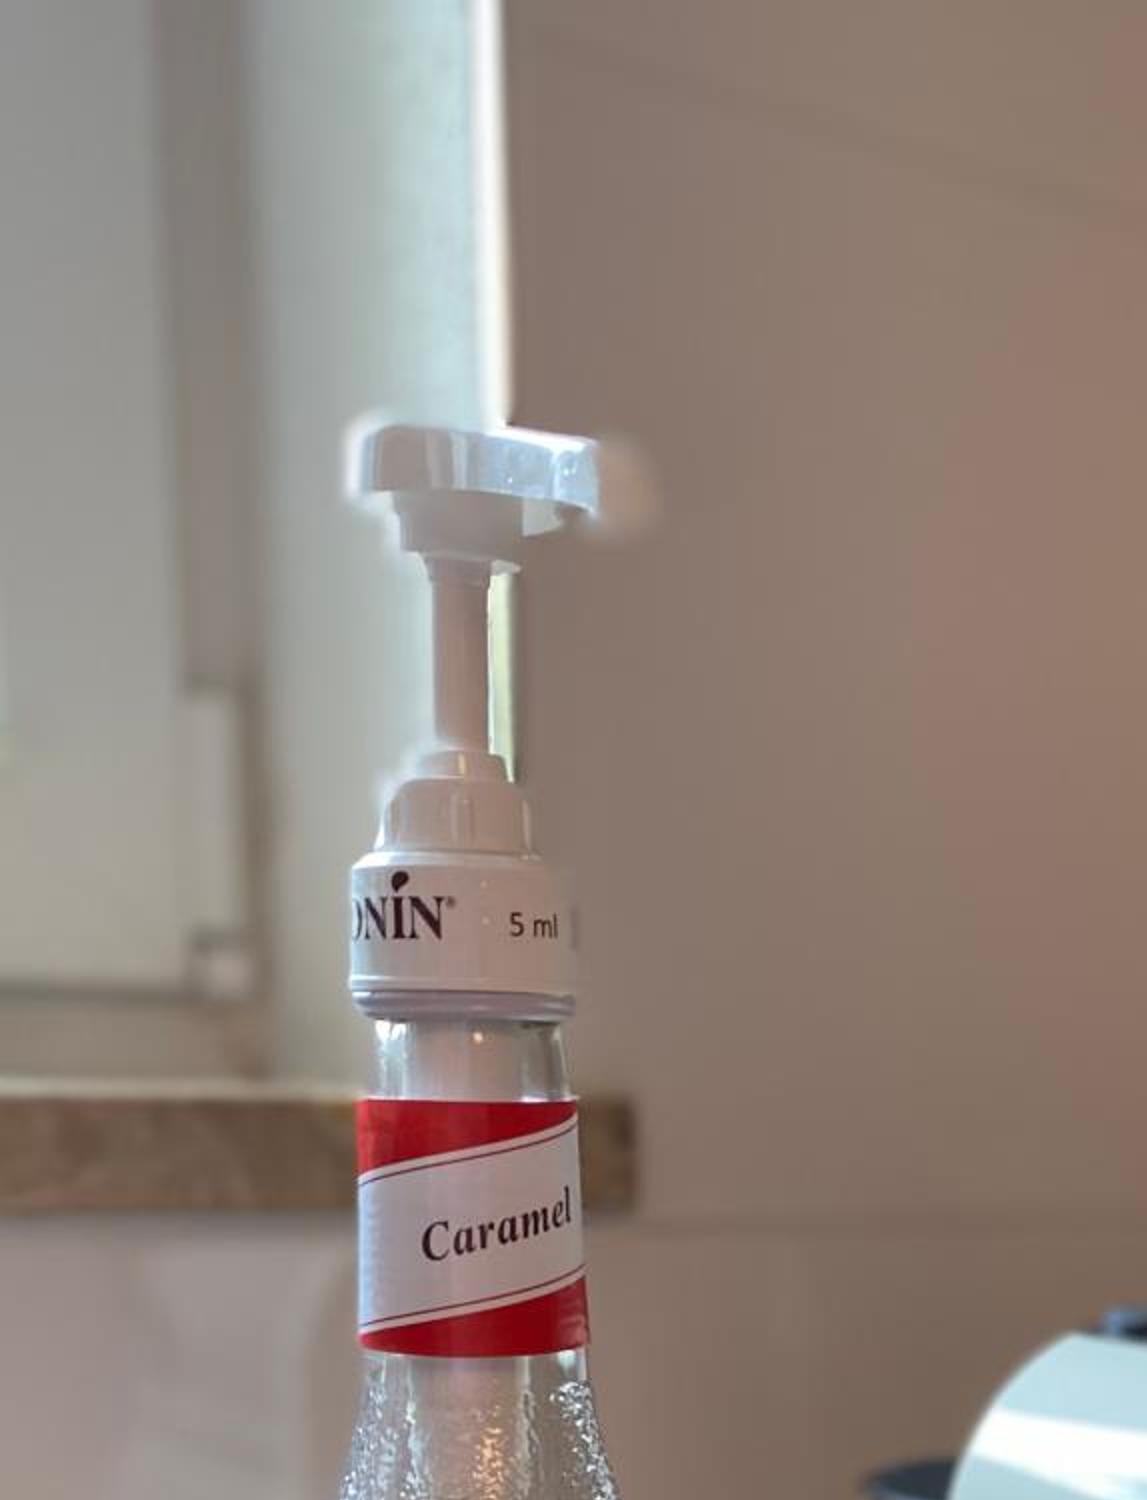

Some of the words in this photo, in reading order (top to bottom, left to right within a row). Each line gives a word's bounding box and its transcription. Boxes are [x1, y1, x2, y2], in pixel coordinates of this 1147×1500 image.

[509, 911, 524, 938] 5
[532, 913, 559, 939] ml
[421, 1184, 571, 1261] Caramel
